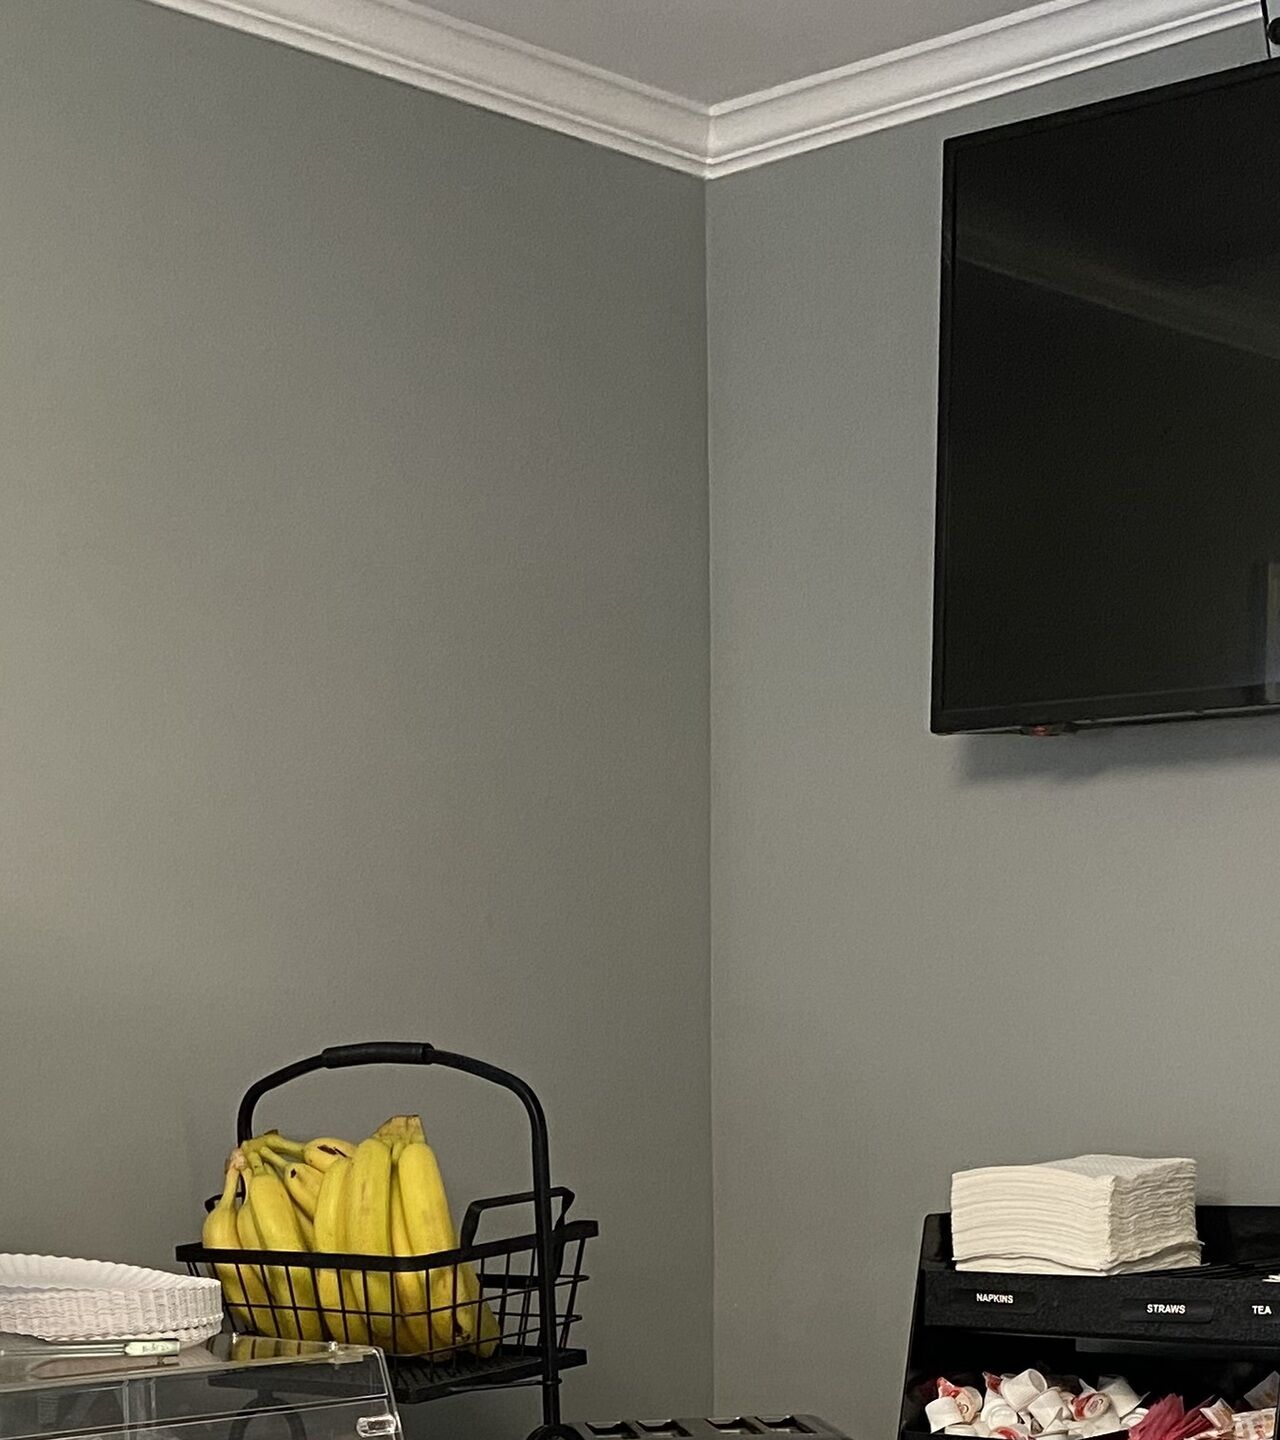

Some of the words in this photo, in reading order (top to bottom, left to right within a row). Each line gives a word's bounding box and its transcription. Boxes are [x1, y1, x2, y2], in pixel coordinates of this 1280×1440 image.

[976, 1292, 1014, 1304] NAPKINS
[1146, 1304, 1186, 1315] STRAWS
[1252, 1305, 1272, 1315] TEA
